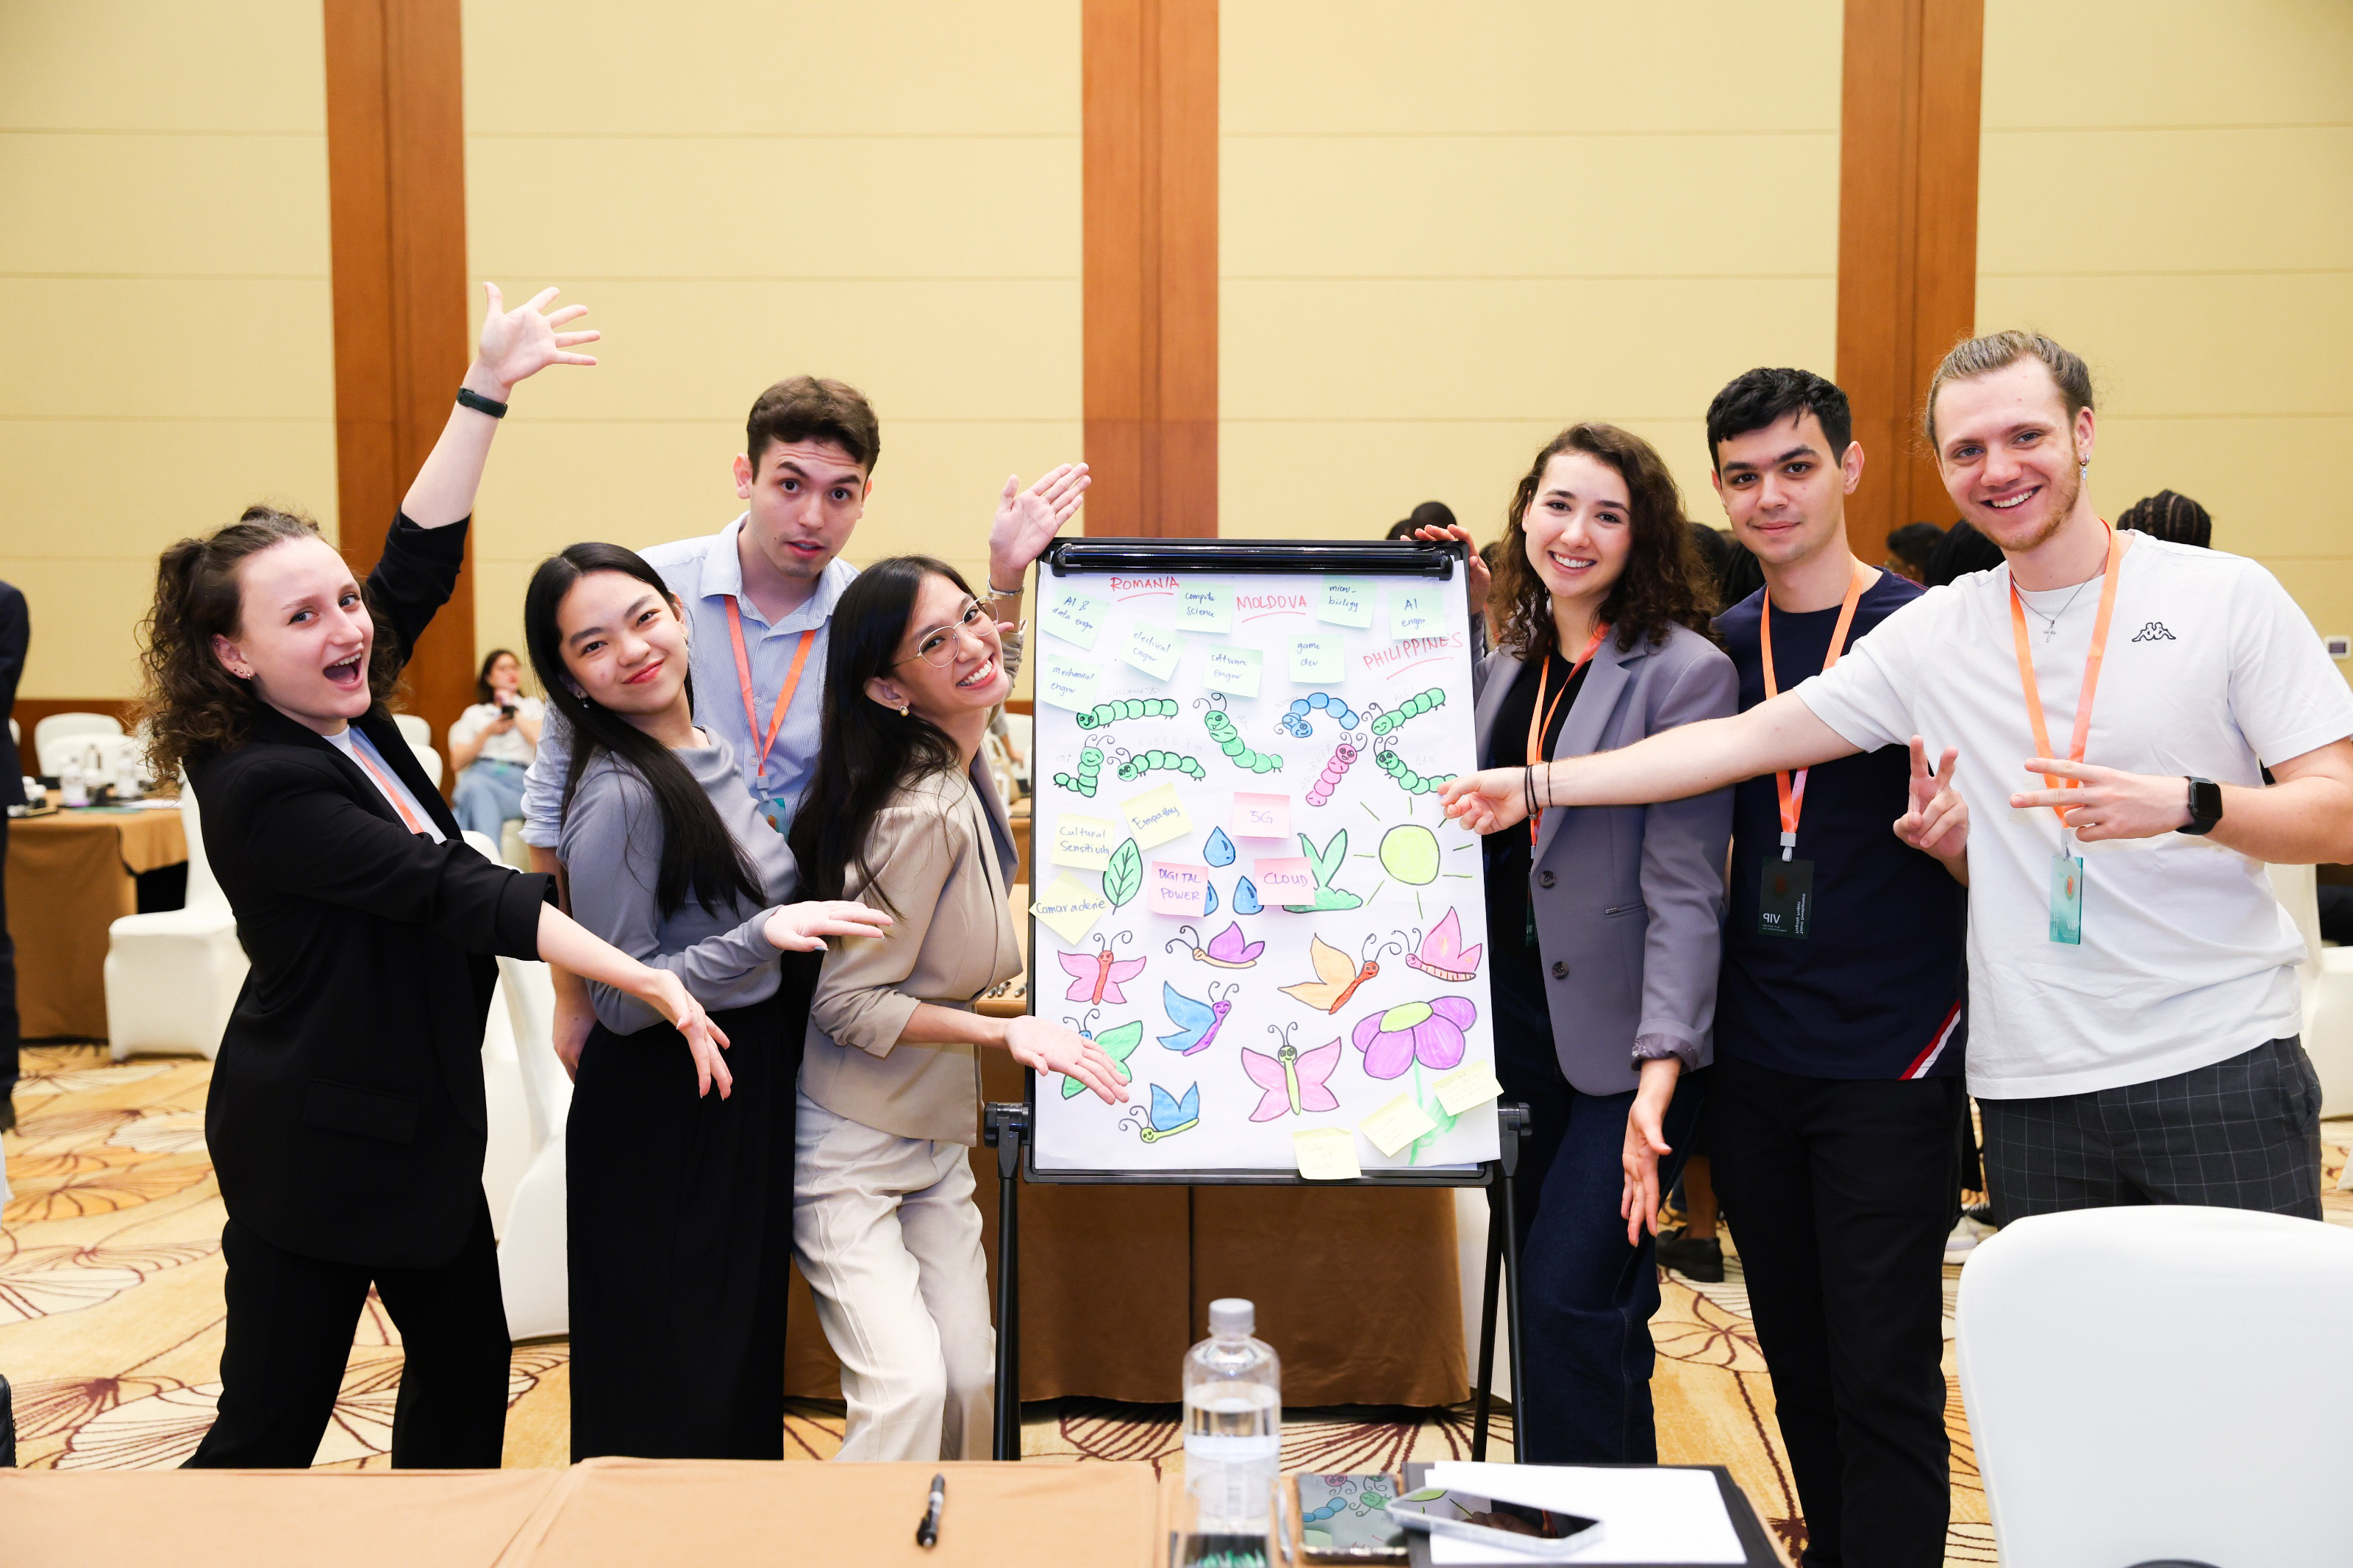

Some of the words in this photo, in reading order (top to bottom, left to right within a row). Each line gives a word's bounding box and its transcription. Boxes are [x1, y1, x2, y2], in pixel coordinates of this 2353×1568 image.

[1110, 576, 1179, 591] ROMANIA
[1237, 595, 1307, 611] MOLDOVA
[1329, 596, 1358, 612] biology
[1297, 642, 1321, 654] game
[1363, 632, 1463, 670] PHILIPPINES
[1137, 737, 1193, 750] AUBREY
[1132, 806, 1180, 829] Empathy
[1249, 810, 1274, 824] 5G
[1060, 826, 1105, 838] Cultural
[1159, 868, 1202, 884] DIGITAL
[1263, 873, 1308, 887] CLOUD
[1160, 887, 1200, 901] POWER
